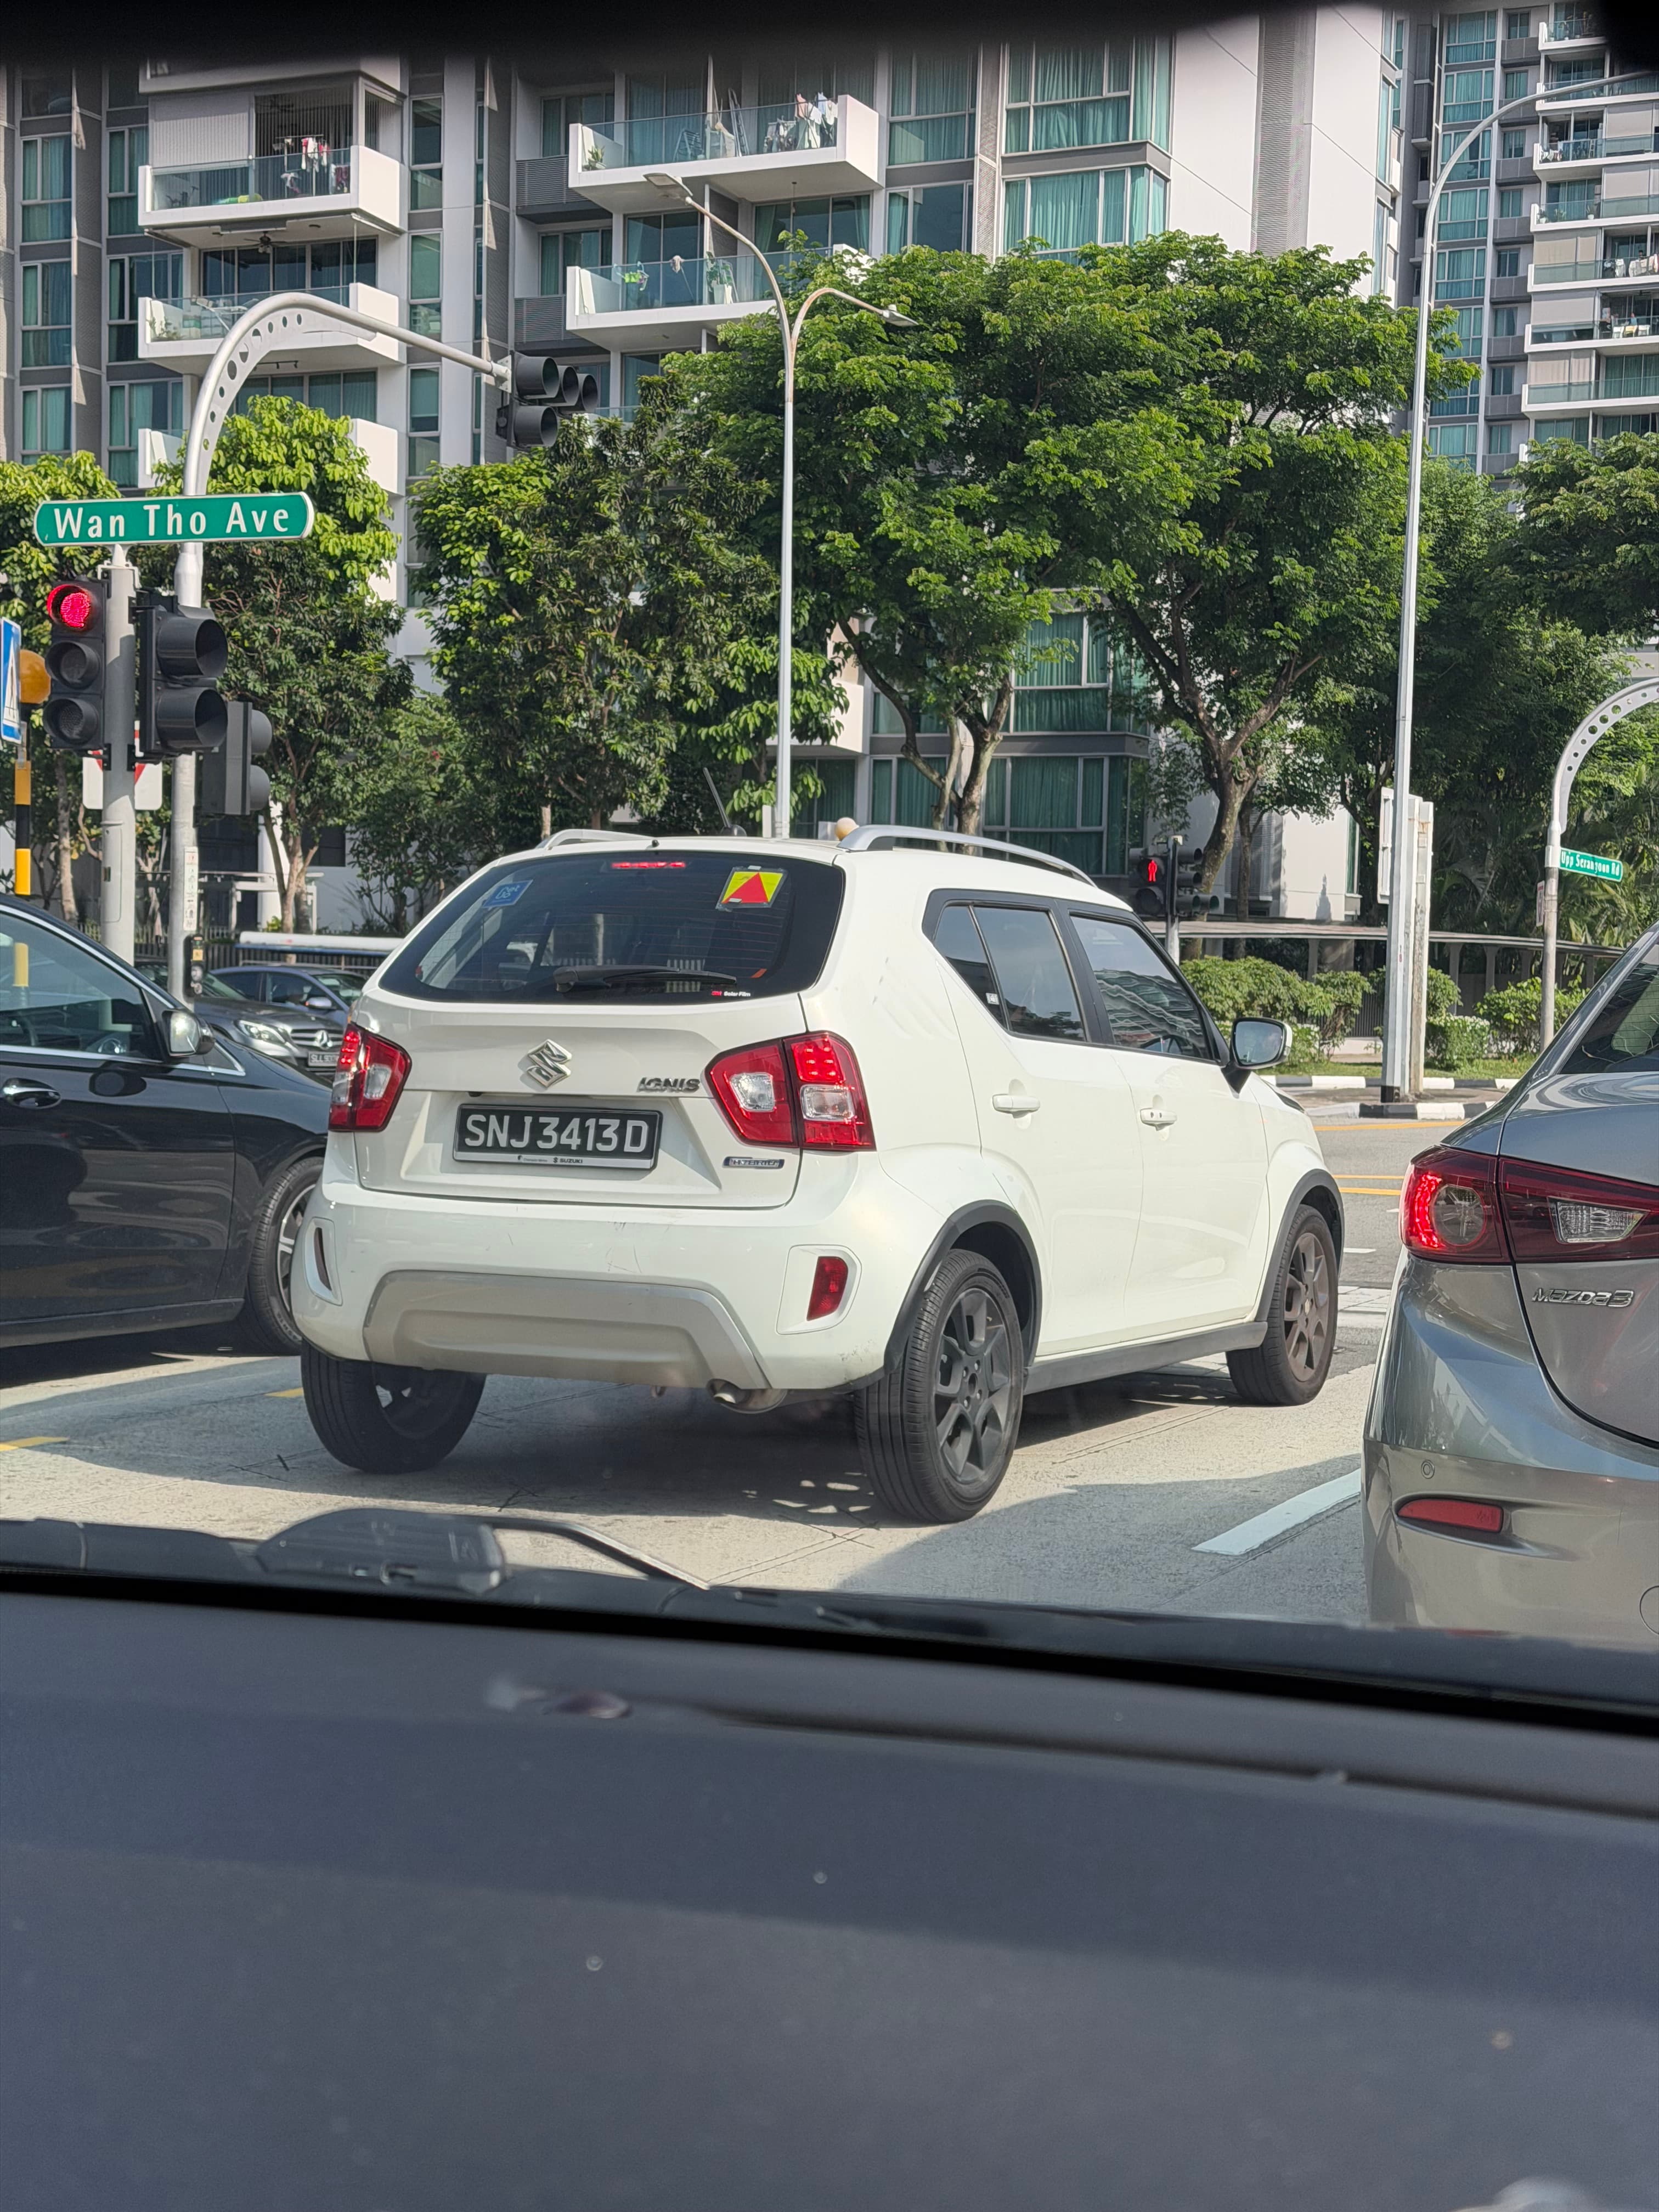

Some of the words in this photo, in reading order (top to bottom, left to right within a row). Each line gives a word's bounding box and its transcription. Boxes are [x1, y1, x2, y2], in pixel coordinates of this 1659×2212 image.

[54, 506, 125, 539] Wan
[143, 504, 206, 537] Tho
[225, 501, 289, 534] Ave
[1561, 851, 1574, 868] Upp
[1576, 854, 1610, 874] Serangoon
[1611, 862, 1620, 876] Rd
[637, 1077, 701, 1093] IGNIS
[464, 1114, 649, 1153] SNJ3413D
